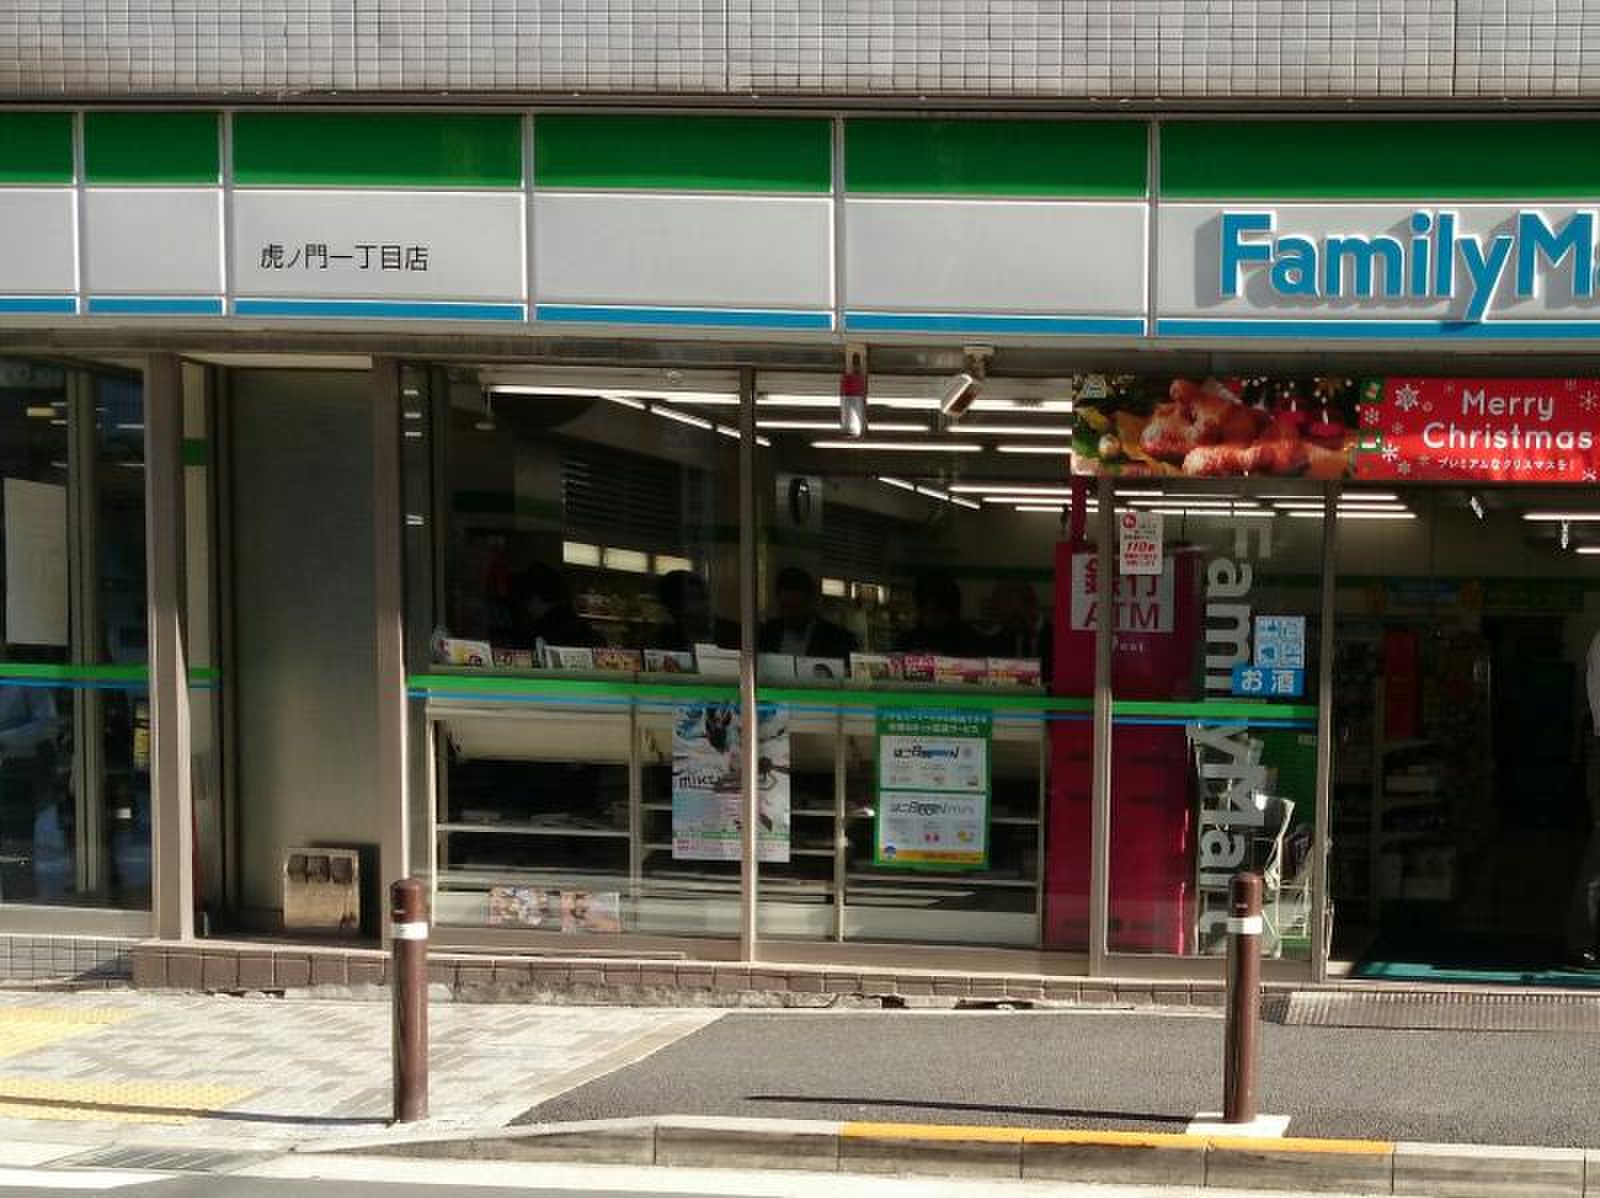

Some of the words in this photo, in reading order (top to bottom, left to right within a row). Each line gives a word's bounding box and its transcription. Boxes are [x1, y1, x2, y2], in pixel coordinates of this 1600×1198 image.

[261, 244, 429, 271] 虎ノ門一丁目店
[1219, 210, 1600, 322] FamilyM
[1461, 388, 1553, 421] Merry
[1423, 421, 1593, 449] Christmas
